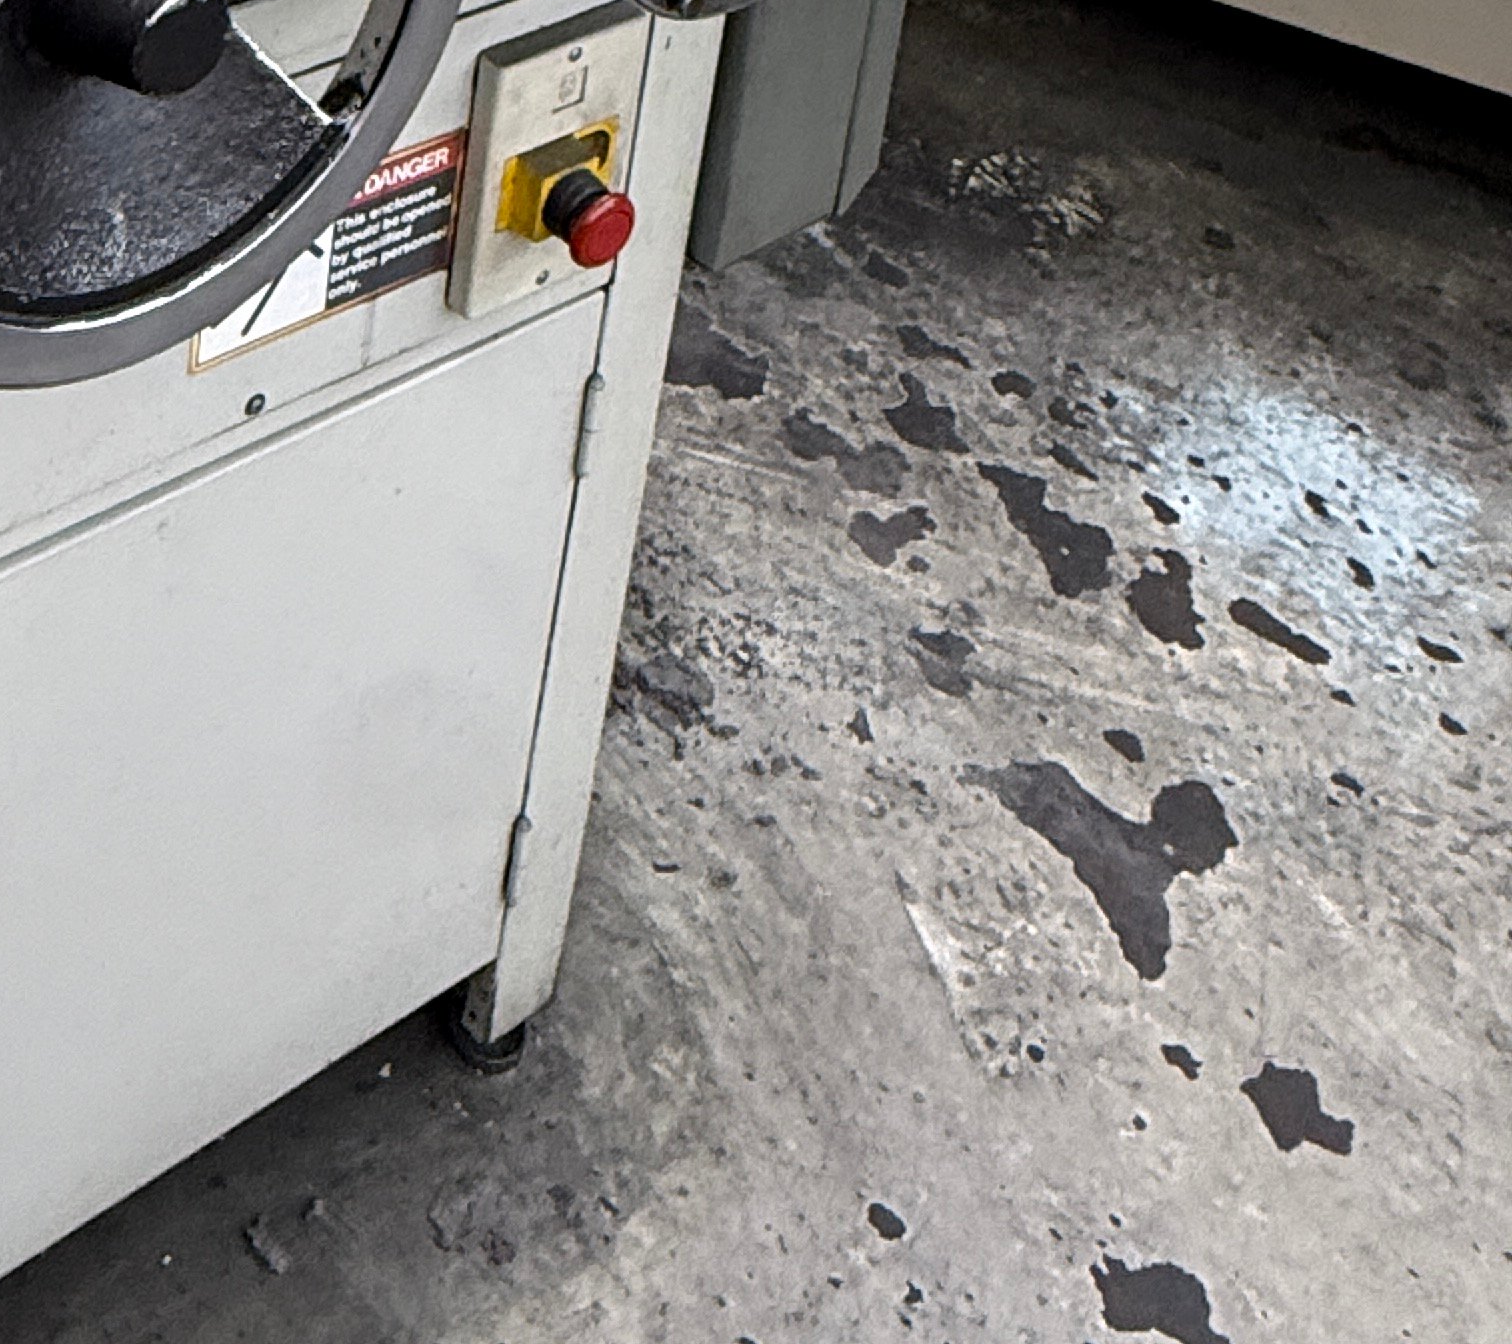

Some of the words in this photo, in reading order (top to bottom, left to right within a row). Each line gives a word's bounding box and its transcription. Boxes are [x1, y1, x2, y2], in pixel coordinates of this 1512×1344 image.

[364, 146, 450, 195] DANGER
[334, 223, 380, 250] should
[382, 215, 400, 231] be
[401, 192, 452, 223] opened
[336, 213, 366, 232] This
[368, 186, 437, 220] enclosure
[330, 256, 378, 284] service
[380, 224, 449, 266] personnel
[332, 251, 350, 267] by
[352, 224, 412, 259] qualified
[328, 279, 361, 300] only.
